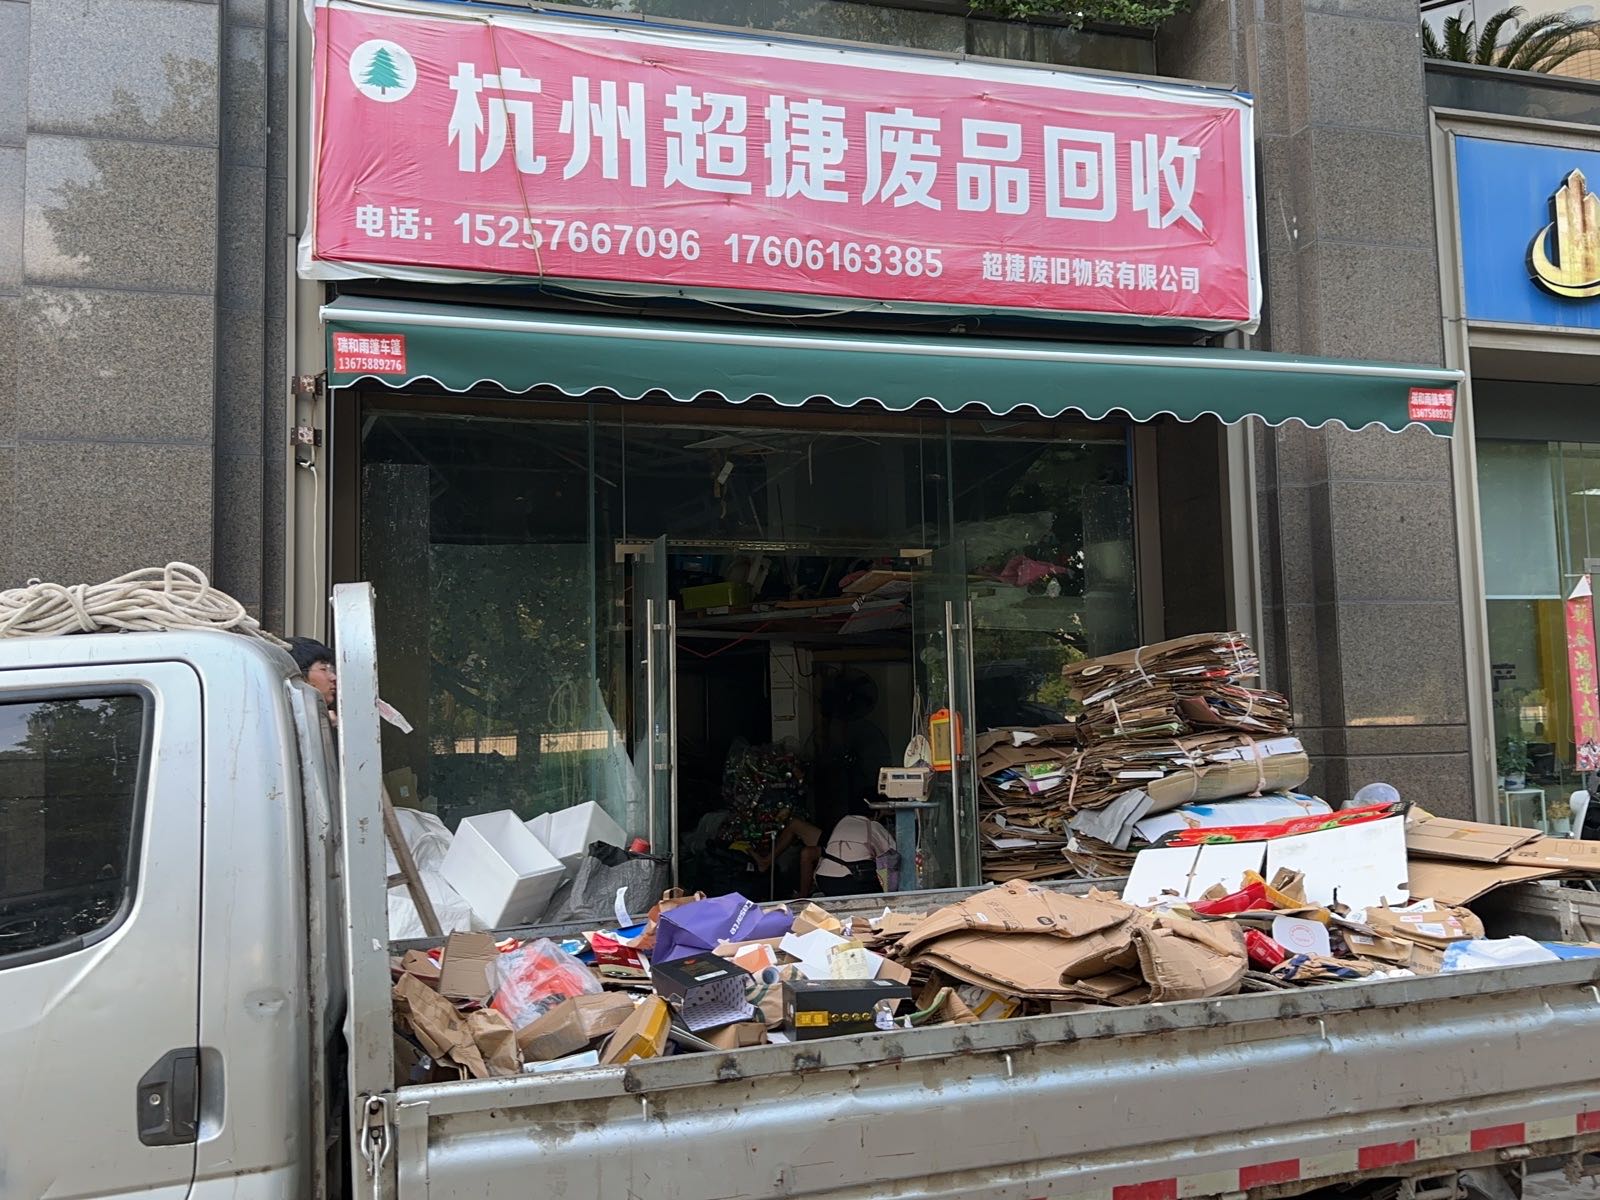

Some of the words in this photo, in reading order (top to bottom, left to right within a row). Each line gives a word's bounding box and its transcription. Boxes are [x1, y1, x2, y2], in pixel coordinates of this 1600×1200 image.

[448, 62, 1204, 231] 杭州超捷废品回收
[454, 212, 701, 261] 15257667096
[724, 233, 944, 278] 17606163385
[982, 252, 1200, 294] 超捷废旧物资有限公司
[339, 357, 402, 371] 13675889276
